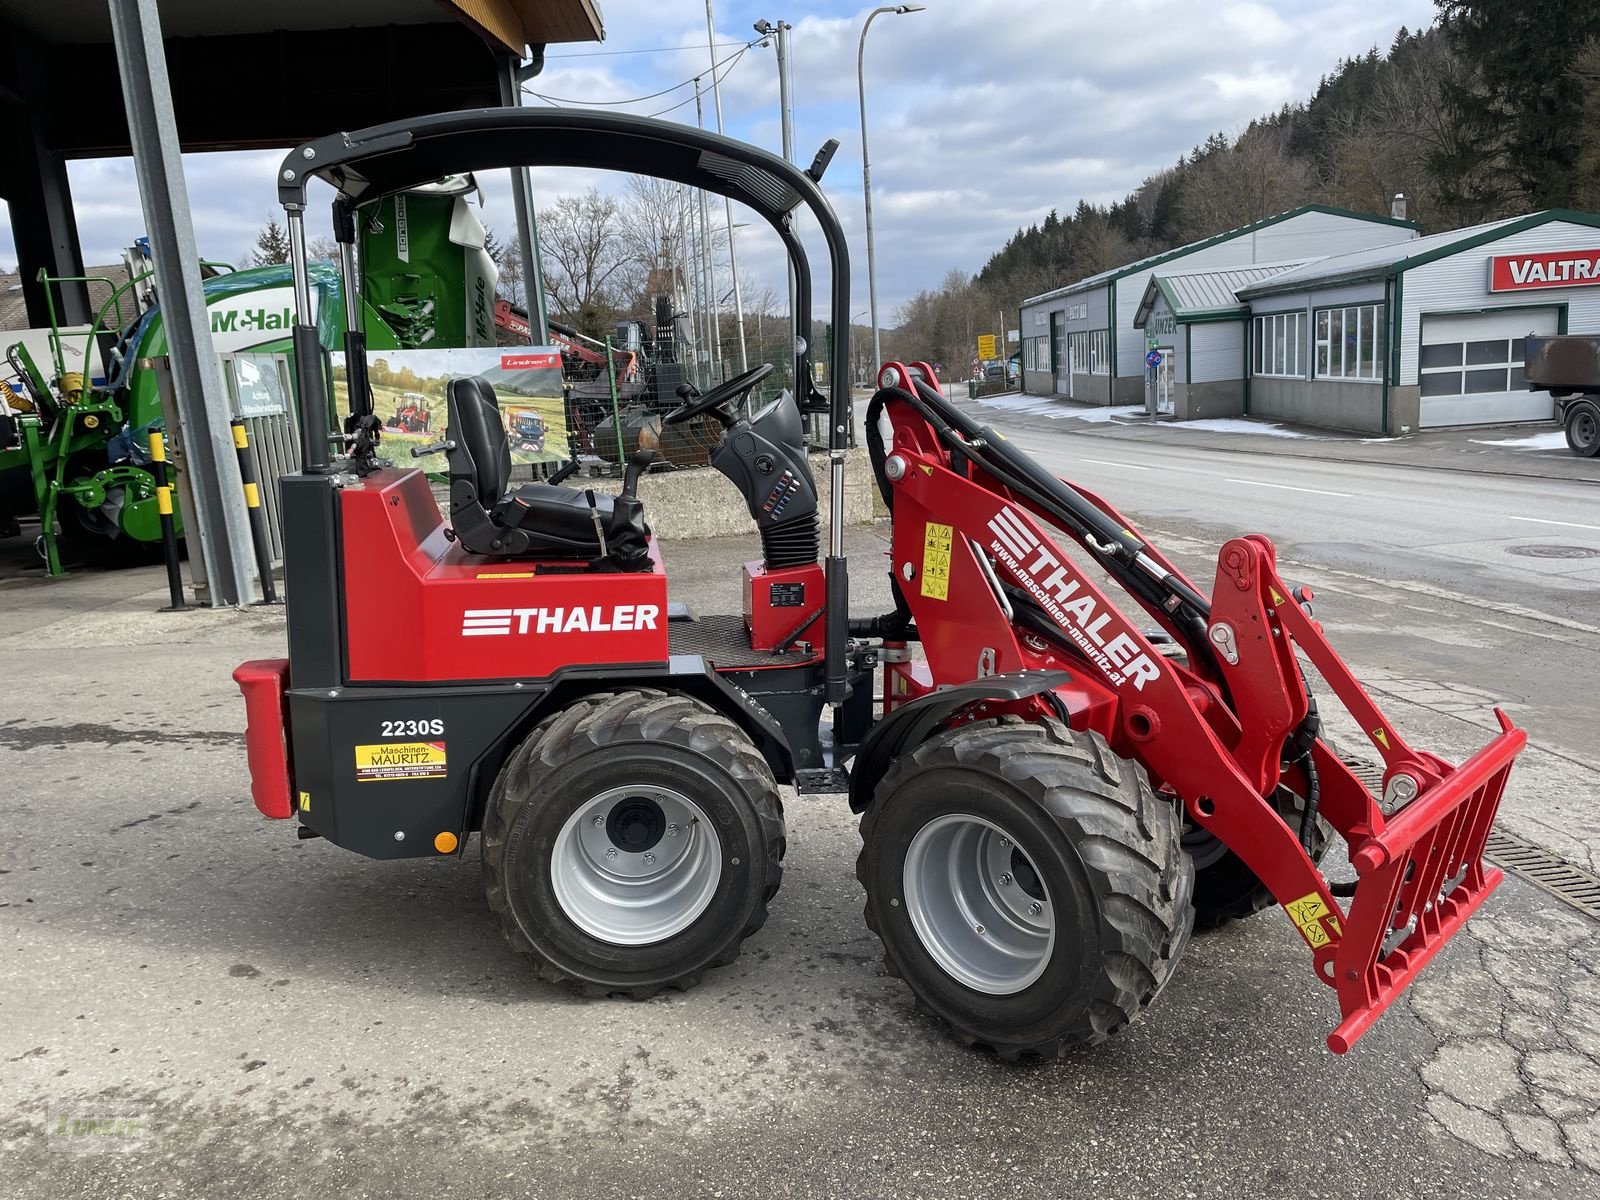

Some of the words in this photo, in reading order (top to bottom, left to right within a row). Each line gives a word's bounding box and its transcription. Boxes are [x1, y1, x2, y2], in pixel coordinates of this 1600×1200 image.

[512, 604, 660, 635] THALER
[990, 540, 1126, 687] www.maschinen-mauritz.at
[1028, 544, 1161, 692] THALER
[381, 718, 444, 737] 2230S
[371, 753, 430, 766] MAURITZ
[380, 745, 430, 755] Maschinen-
